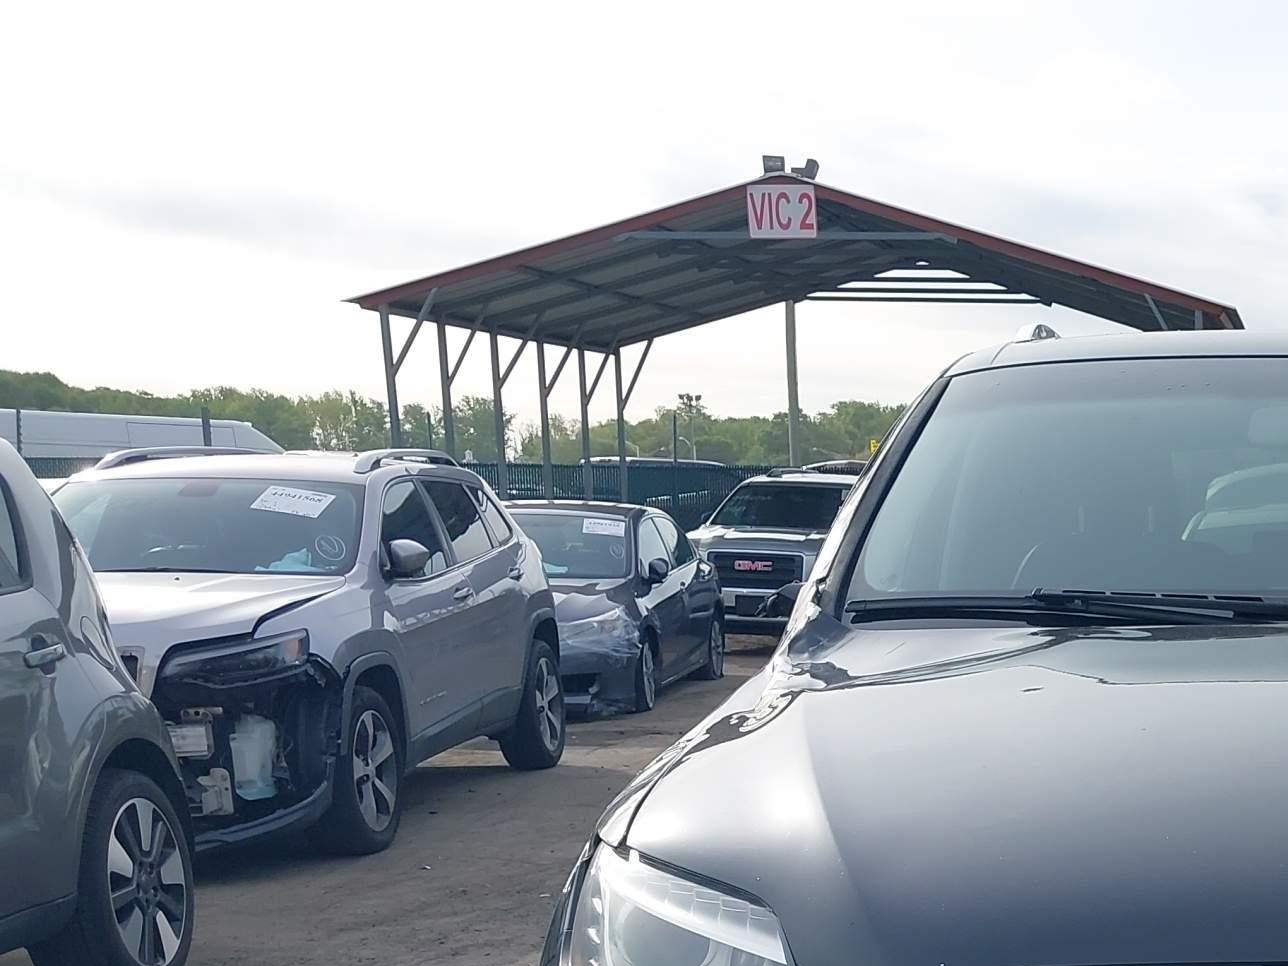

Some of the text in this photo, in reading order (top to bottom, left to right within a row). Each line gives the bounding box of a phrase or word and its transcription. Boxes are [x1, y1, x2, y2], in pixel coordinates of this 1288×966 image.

[749, 191, 815, 231] VIC 2
[734, 560, 773, 571] GMC
